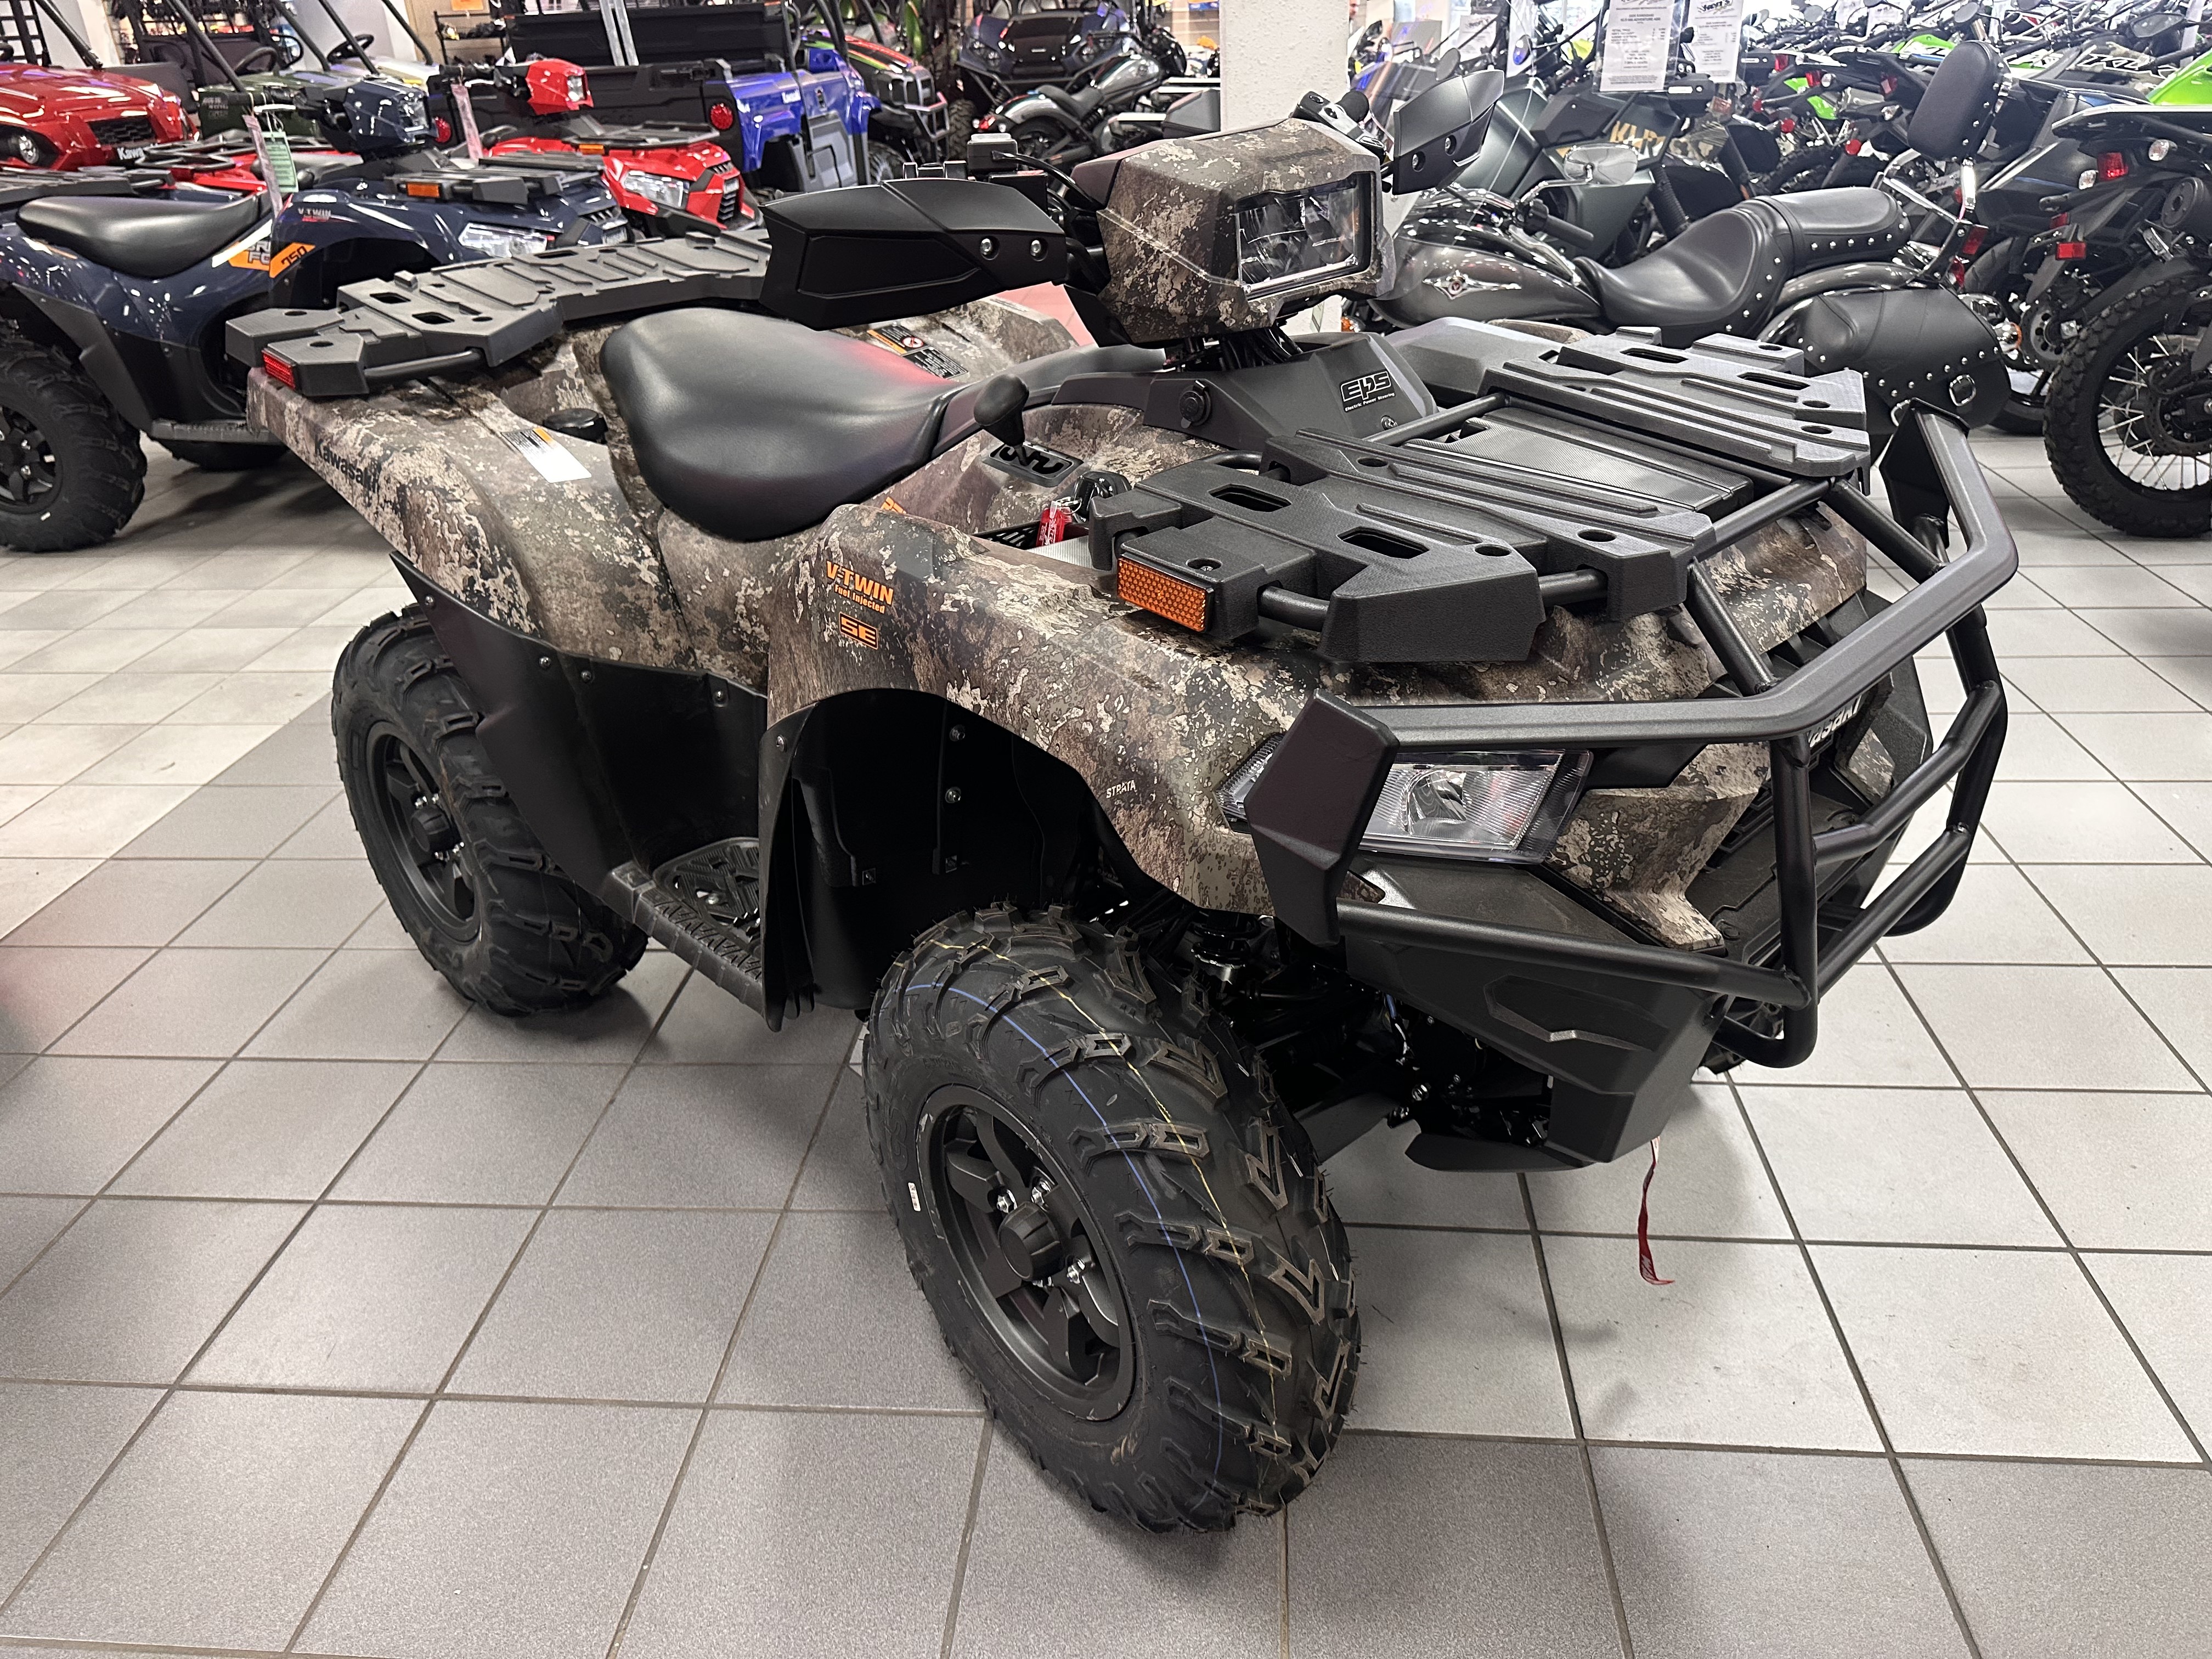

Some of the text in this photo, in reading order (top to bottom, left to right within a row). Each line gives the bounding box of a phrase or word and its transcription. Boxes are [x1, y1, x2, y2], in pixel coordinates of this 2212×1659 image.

[281, 246, 308, 266] 750
[1341, 371, 1391, 402] EPS
[314, 433, 380, 494] Kawasaki
[826, 560, 894, 606] V-TWIN
[834, 584, 885, 614] Fuel Injected
[840, 616, 876, 646] SE
[1106, 780, 1136, 799] STRATA
